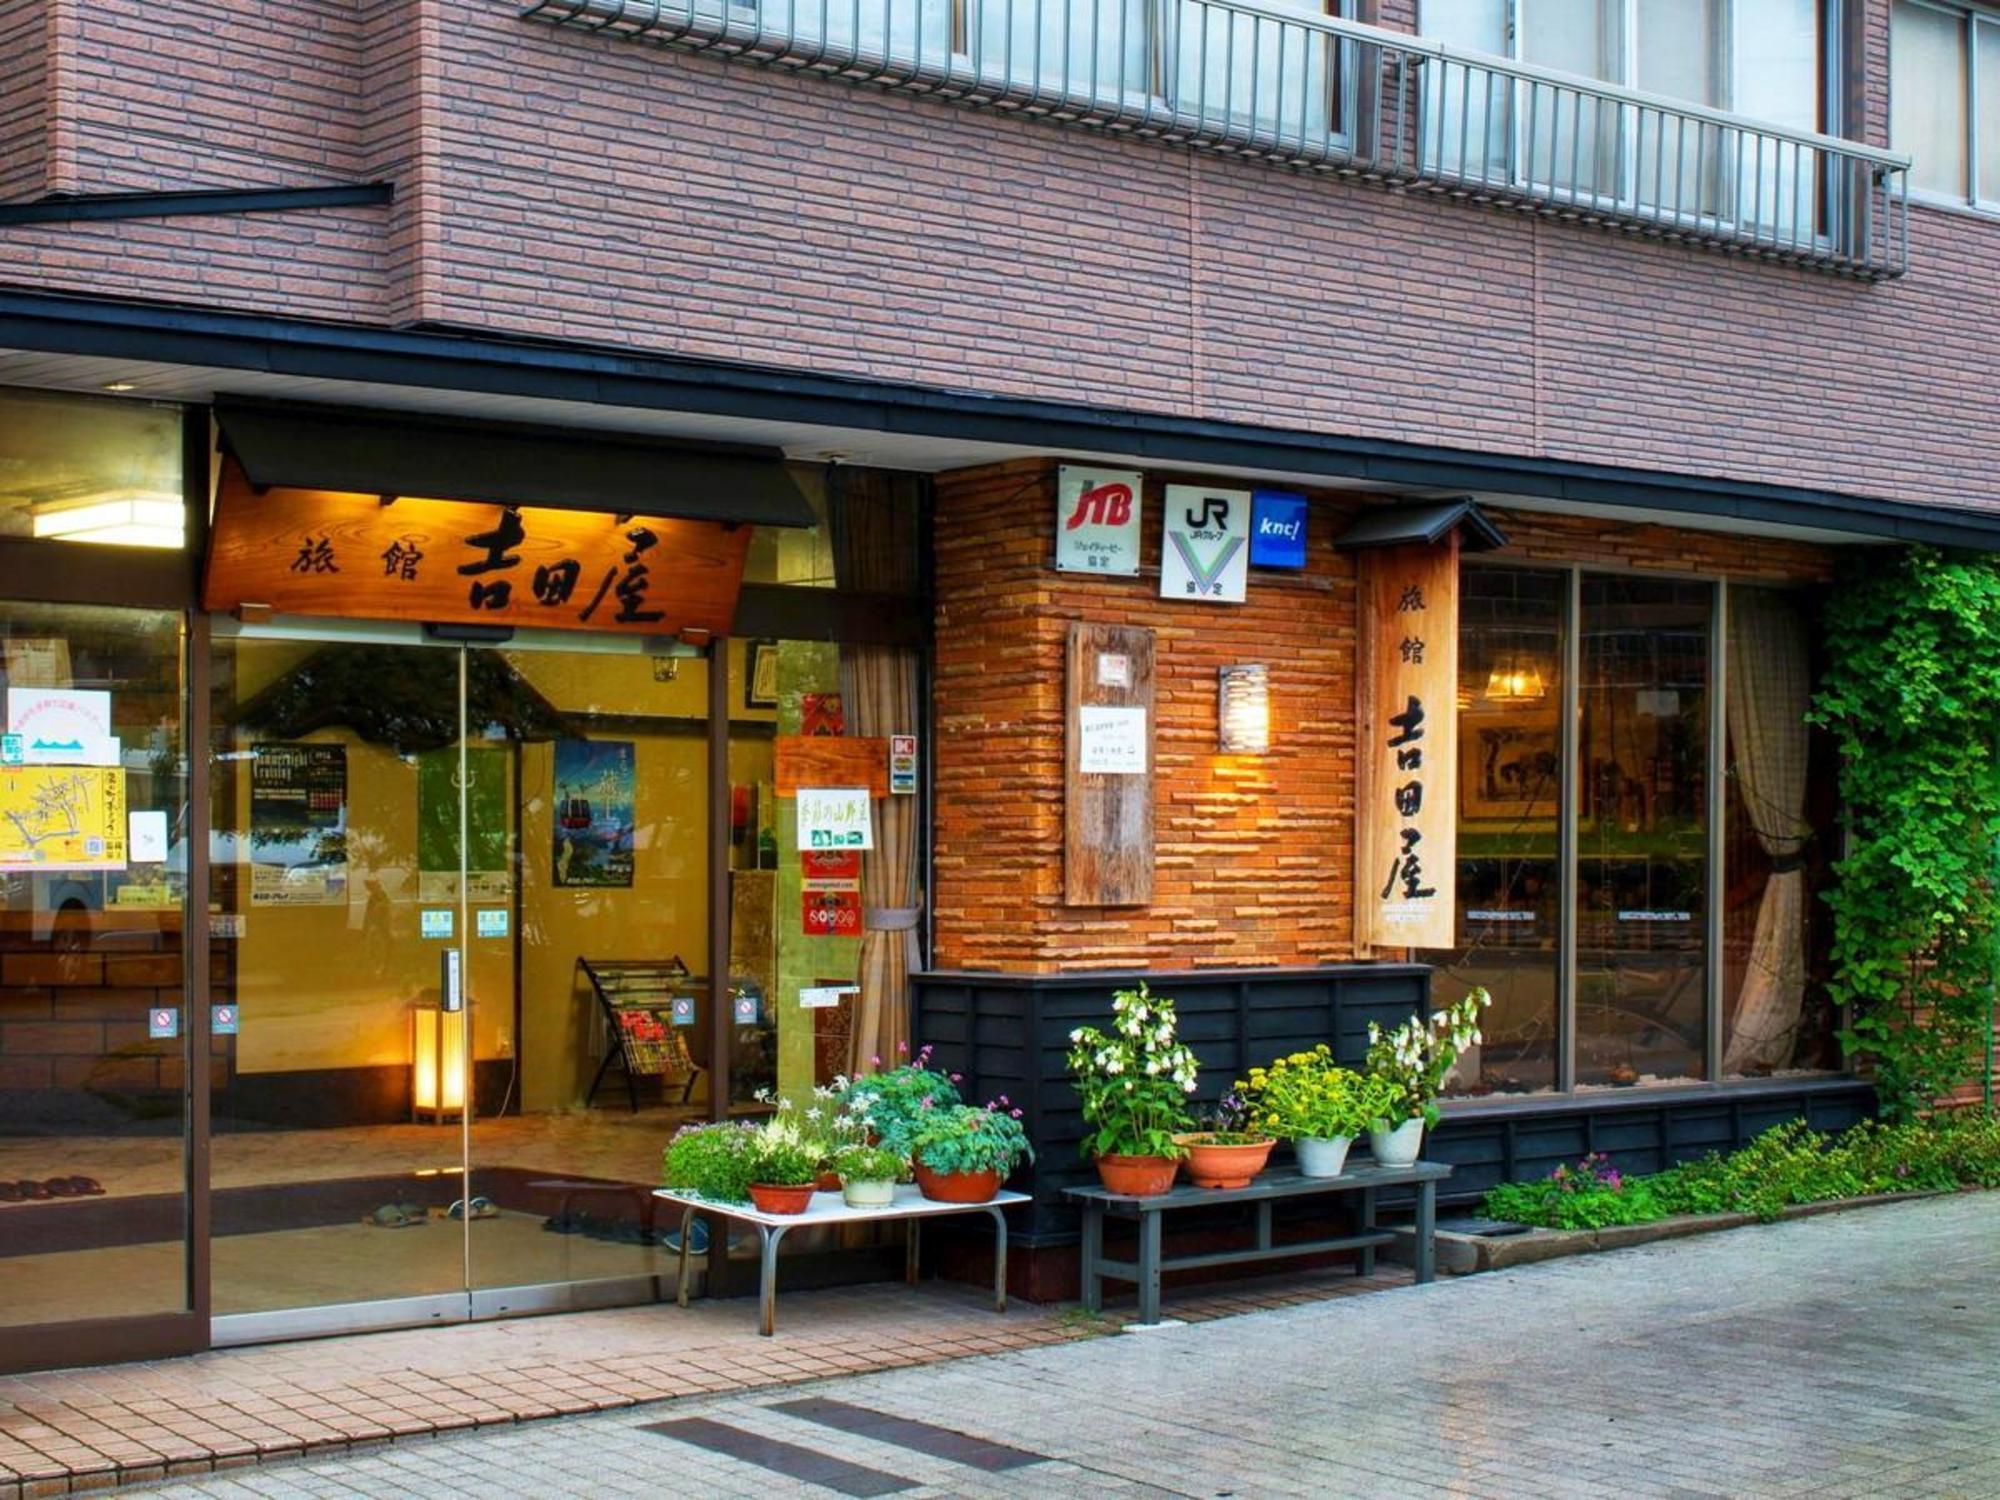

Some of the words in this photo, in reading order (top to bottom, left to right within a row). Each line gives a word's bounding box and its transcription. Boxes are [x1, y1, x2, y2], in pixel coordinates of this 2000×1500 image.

[1066, 480, 1133, 530] JTB
[1186, 498, 1229, 530] JR
[291, 536, 425, 581] 旅館
[457, 506, 666, 624] 吉田屋
[1397, 585, 1427, 665] 旅館
[1381, 695, 1436, 899] 吉田屋
